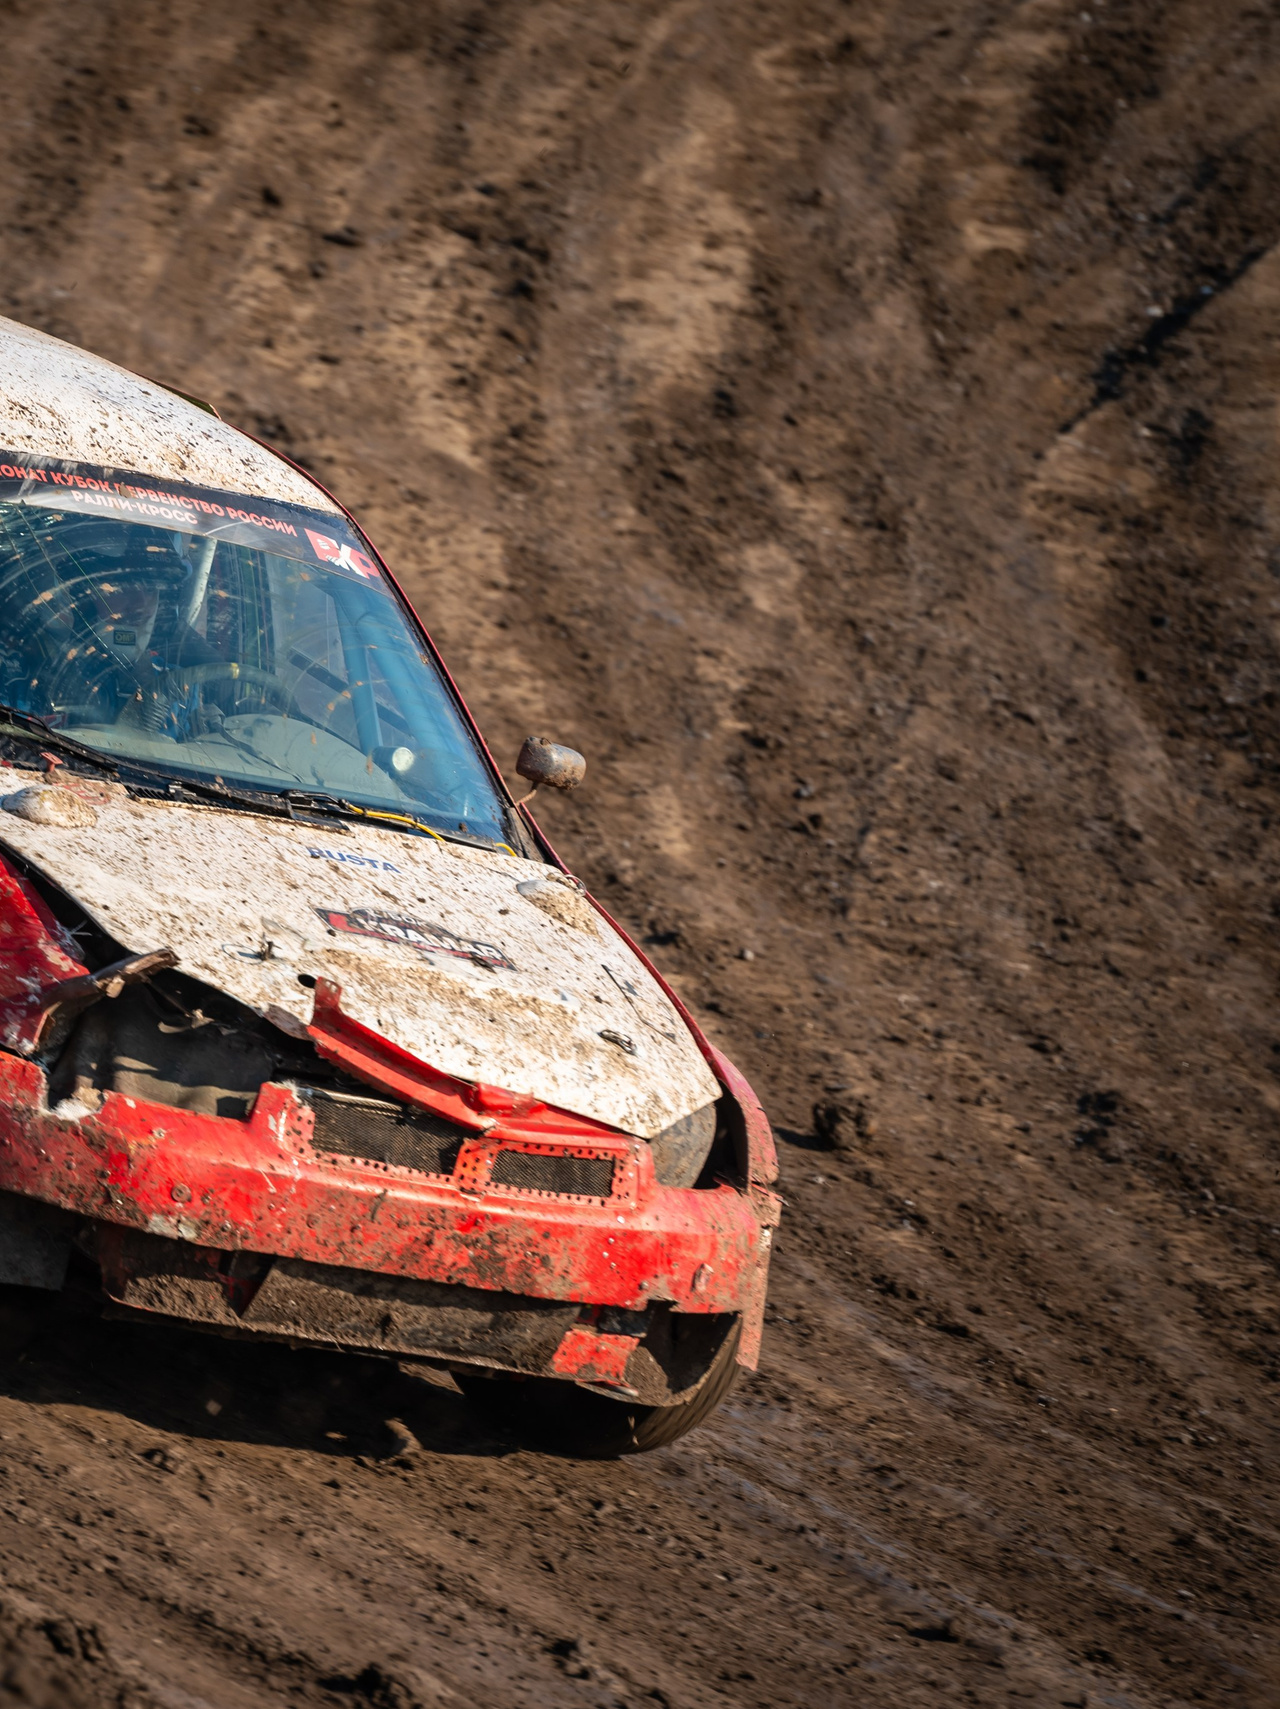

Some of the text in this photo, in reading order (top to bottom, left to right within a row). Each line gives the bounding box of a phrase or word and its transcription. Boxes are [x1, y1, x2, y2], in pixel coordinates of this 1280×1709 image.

[49, 471, 110, 493] КУБОК
[225, 506, 298, 538] РОССИИ
[71, 490, 198, 525] РАЛЛИ-КРОСС
[306, 847, 401, 874] RUSTA
[355, 916, 503, 959] KRAMAR
